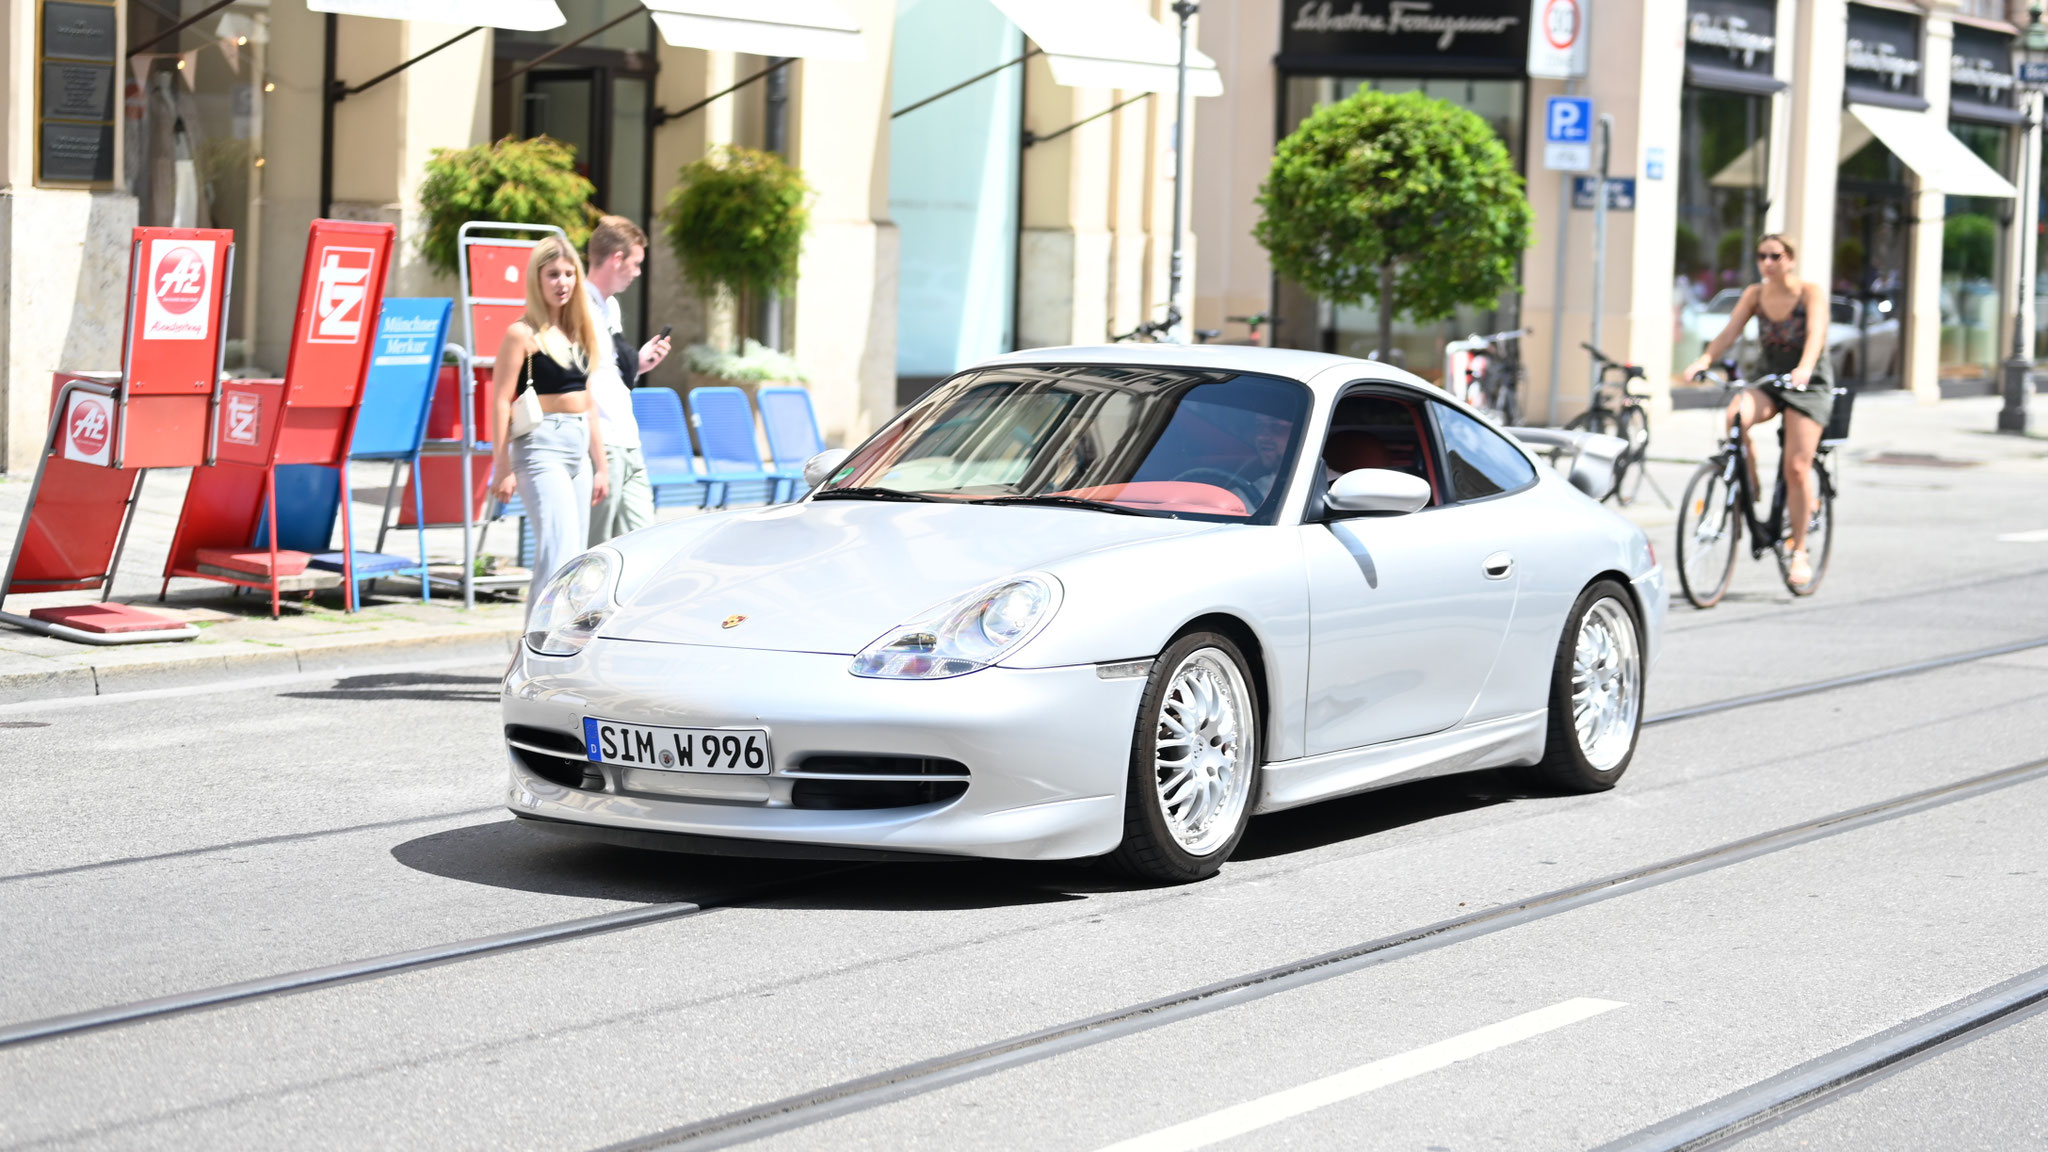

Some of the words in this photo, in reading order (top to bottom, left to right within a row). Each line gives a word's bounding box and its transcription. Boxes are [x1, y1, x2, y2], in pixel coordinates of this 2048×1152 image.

[1551, 101, 1580, 139] P
[318, 254, 371, 336] tz
[385, 338, 428, 354] Merkur
[228, 396, 255, 440] tz
[591, 743, 597, 754] D
[600, 725, 655, 764] SIM
[673, 733, 693, 767] W
[702, 735, 764, 768] 996
